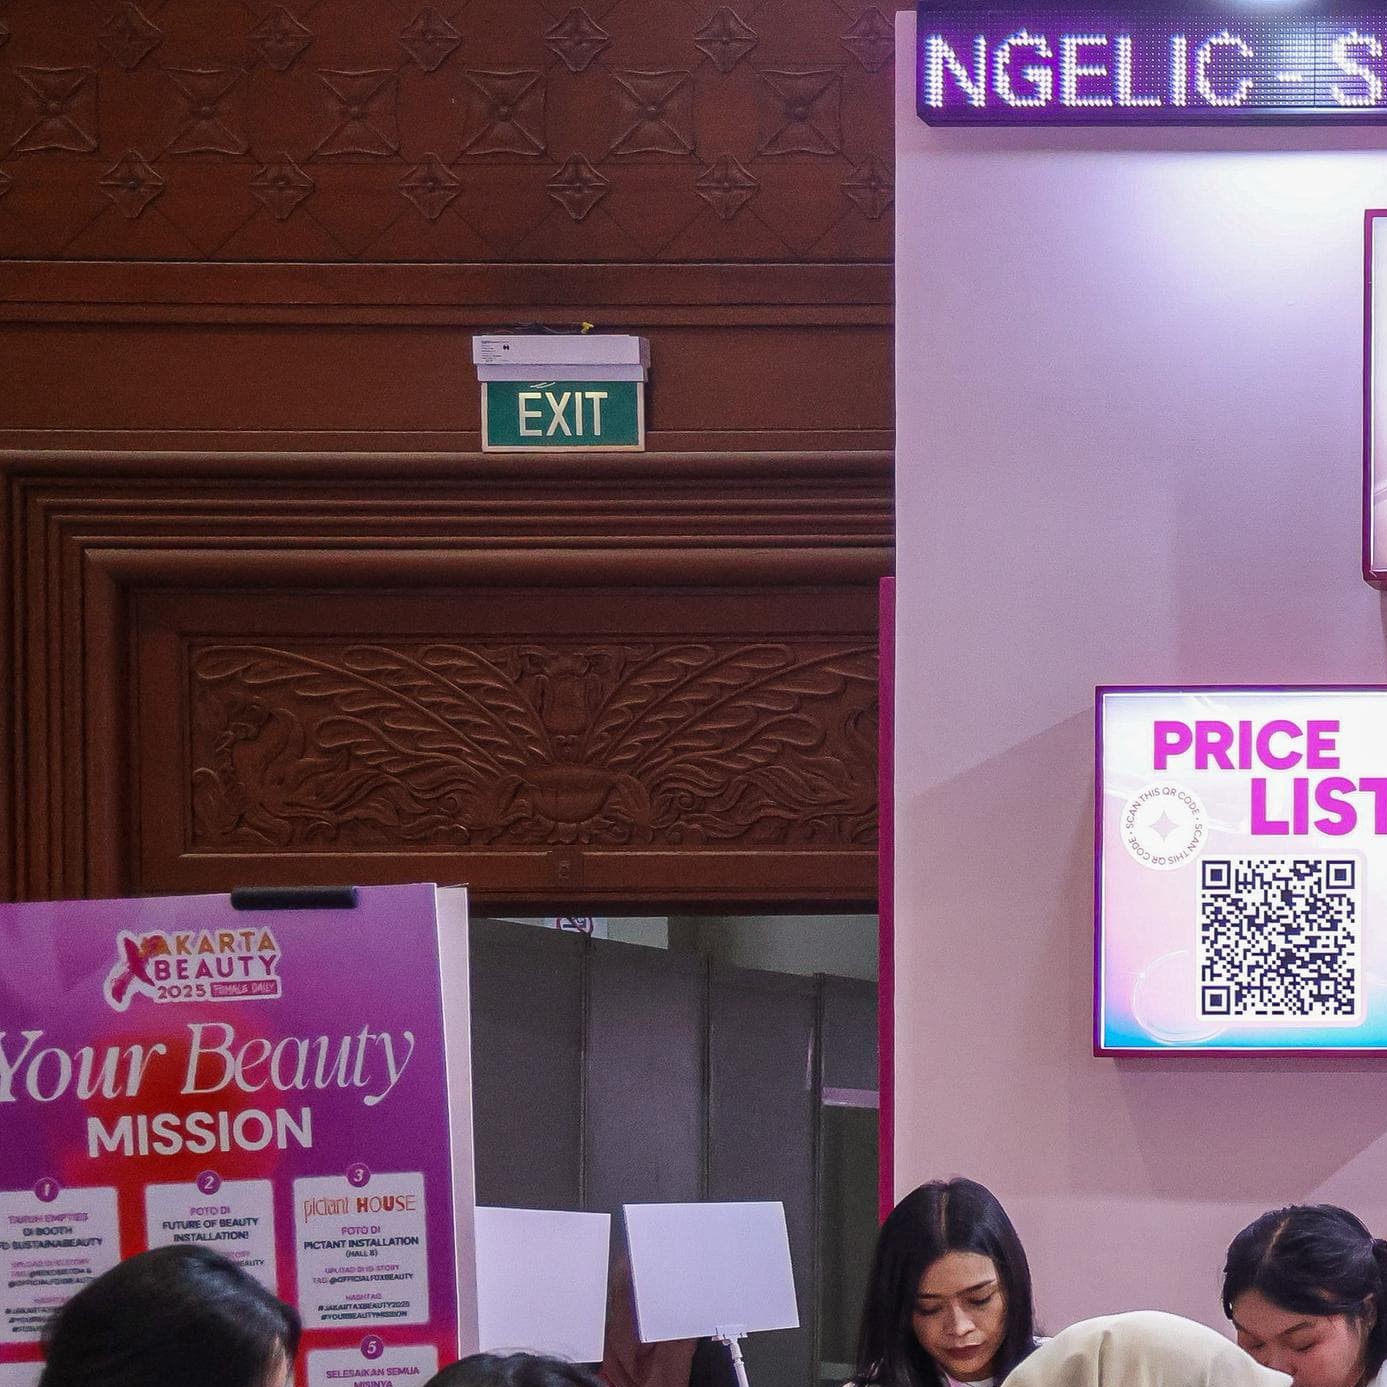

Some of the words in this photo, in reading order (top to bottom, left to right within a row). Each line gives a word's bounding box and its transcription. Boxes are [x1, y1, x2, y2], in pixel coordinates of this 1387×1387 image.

[518, 392, 608, 436] EXIT
[1154, 720, 1340, 770] PRICE
[158, 985, 207, 999] 2025
[0, 1029, 167, 1102] Your
[180, 1022, 415, 1106] Beauty
[87, 1107, 313, 1158] MISSION
